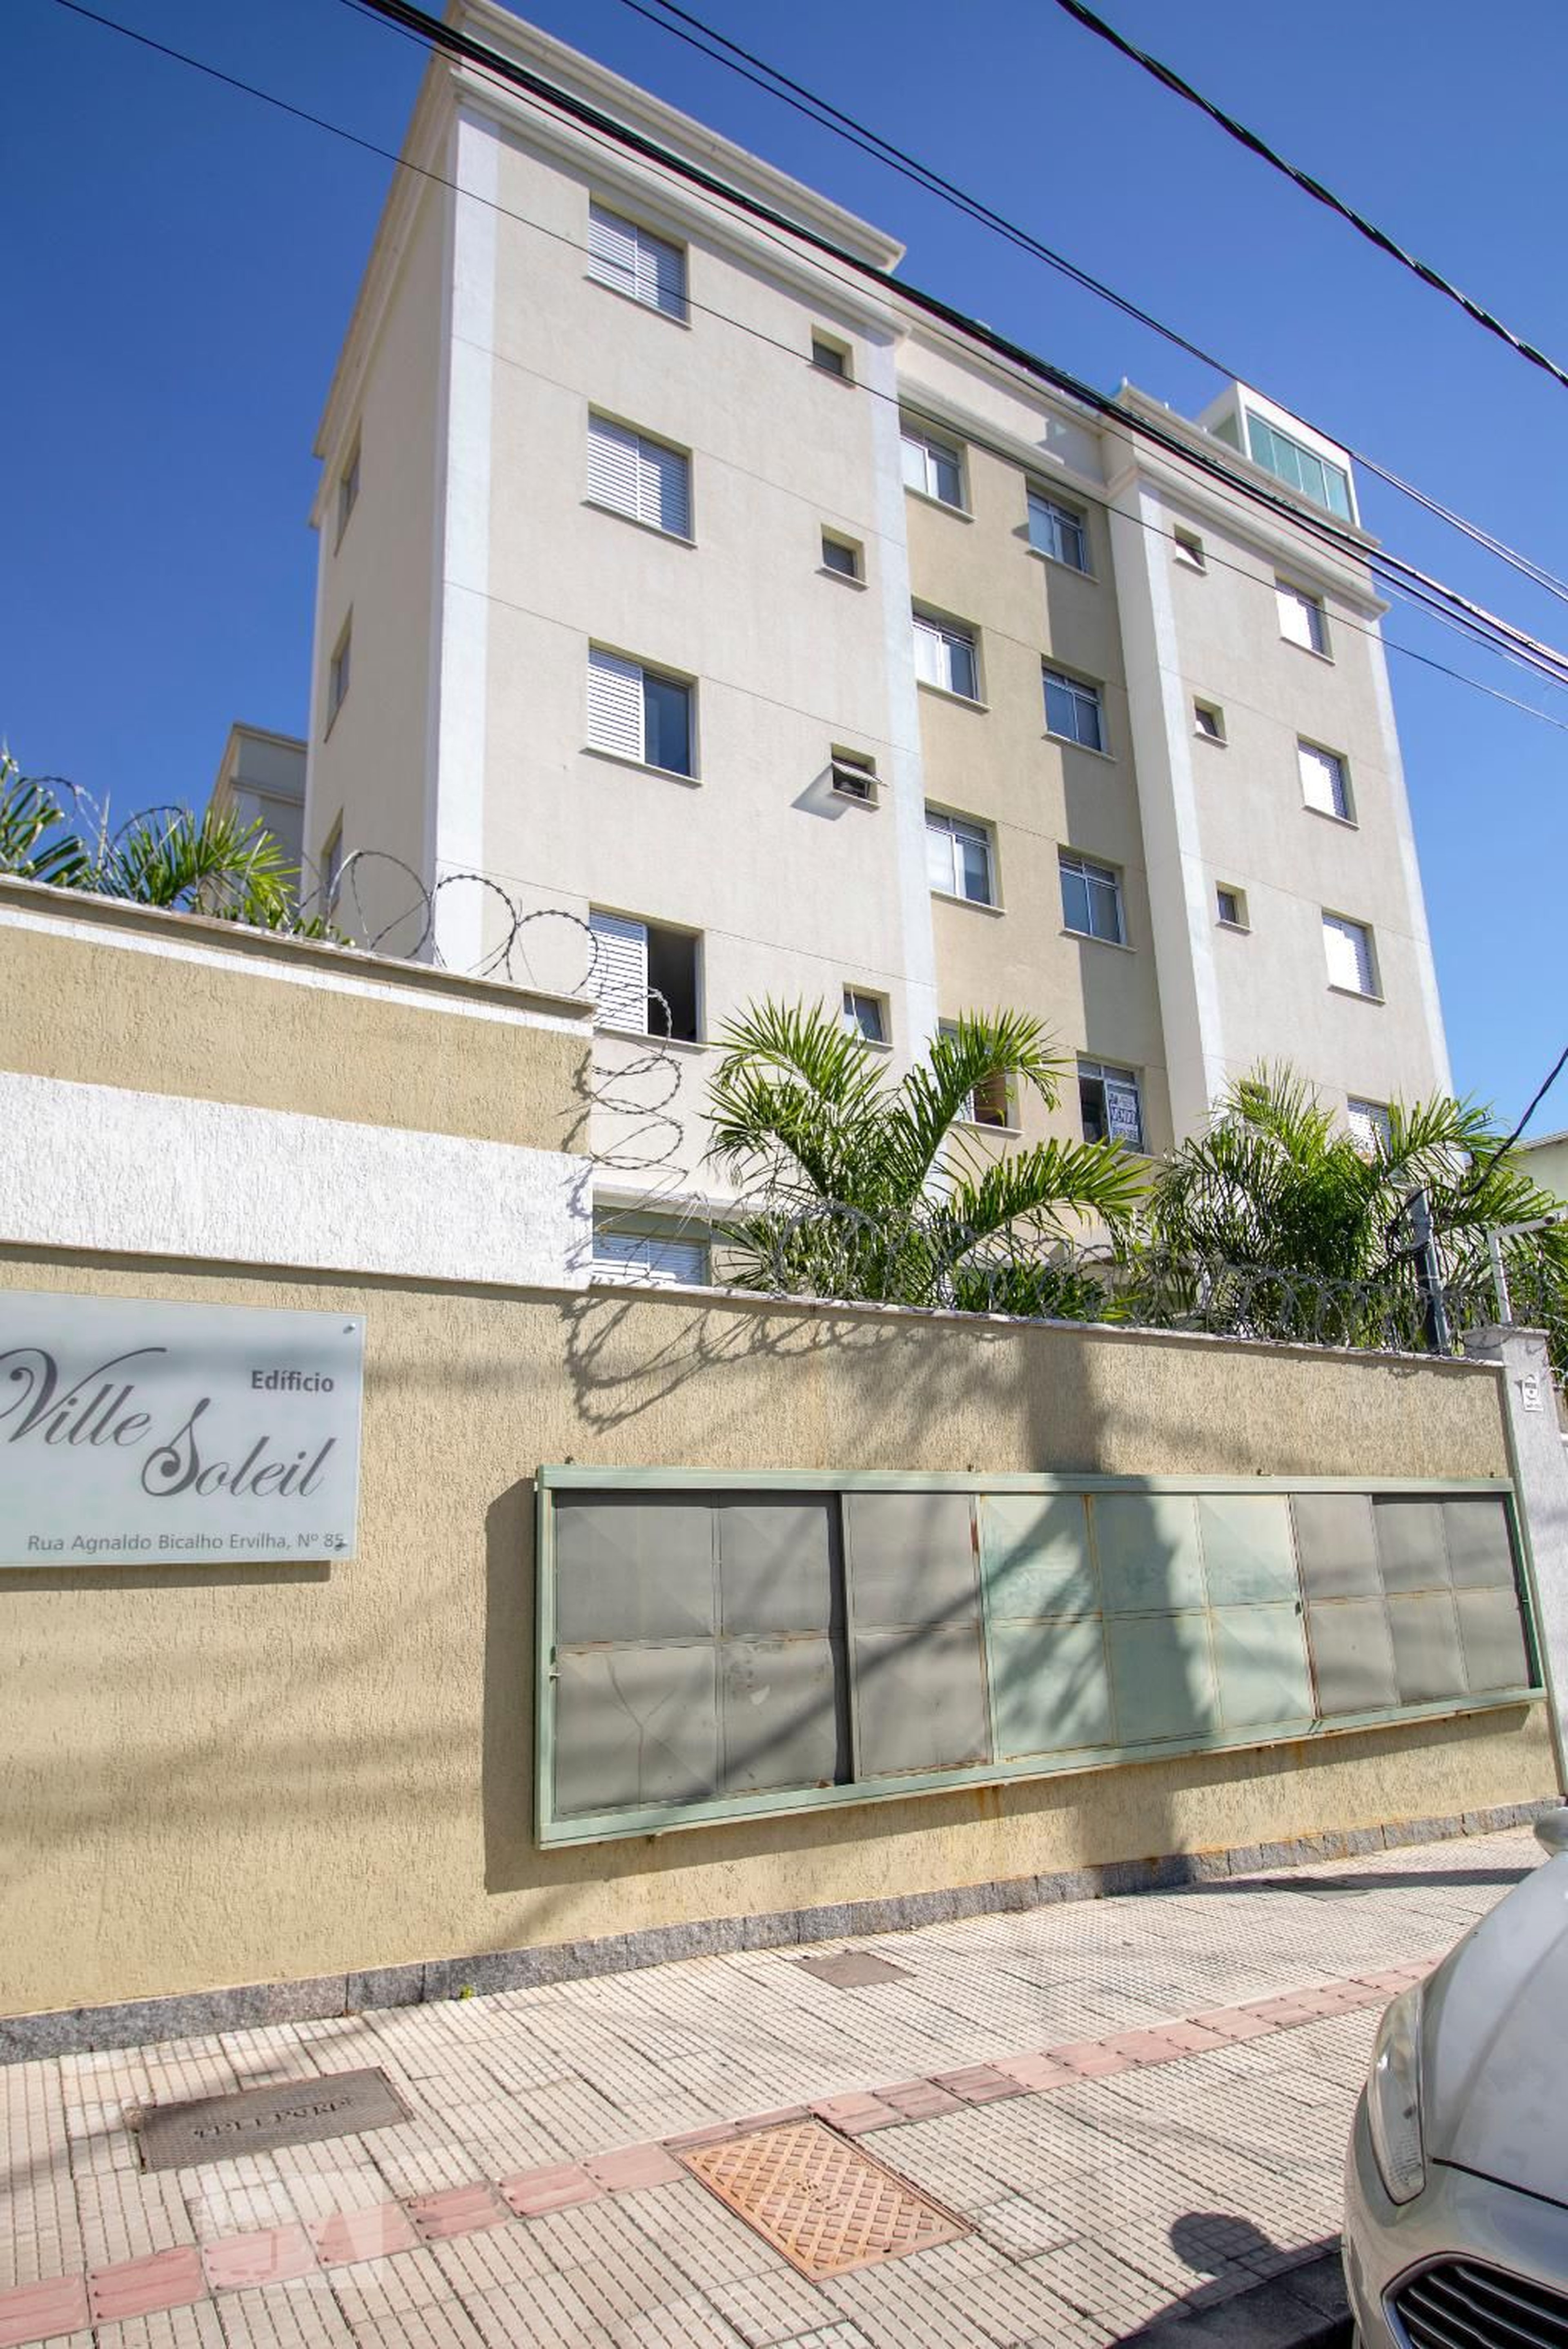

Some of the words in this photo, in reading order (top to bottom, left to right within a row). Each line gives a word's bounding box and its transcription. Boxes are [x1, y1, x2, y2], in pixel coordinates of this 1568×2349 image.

[0, 1347, 167, 1446] Ville
[142, 1398, 336, 1497] Soleil
[28, 1535, 64, 1550] Rua
[71, 1534, 151, 1554] Agnaldo
[159, 1533, 223, 1549] Bicalho
[230, 1532, 290, 1550] Ervilha,
